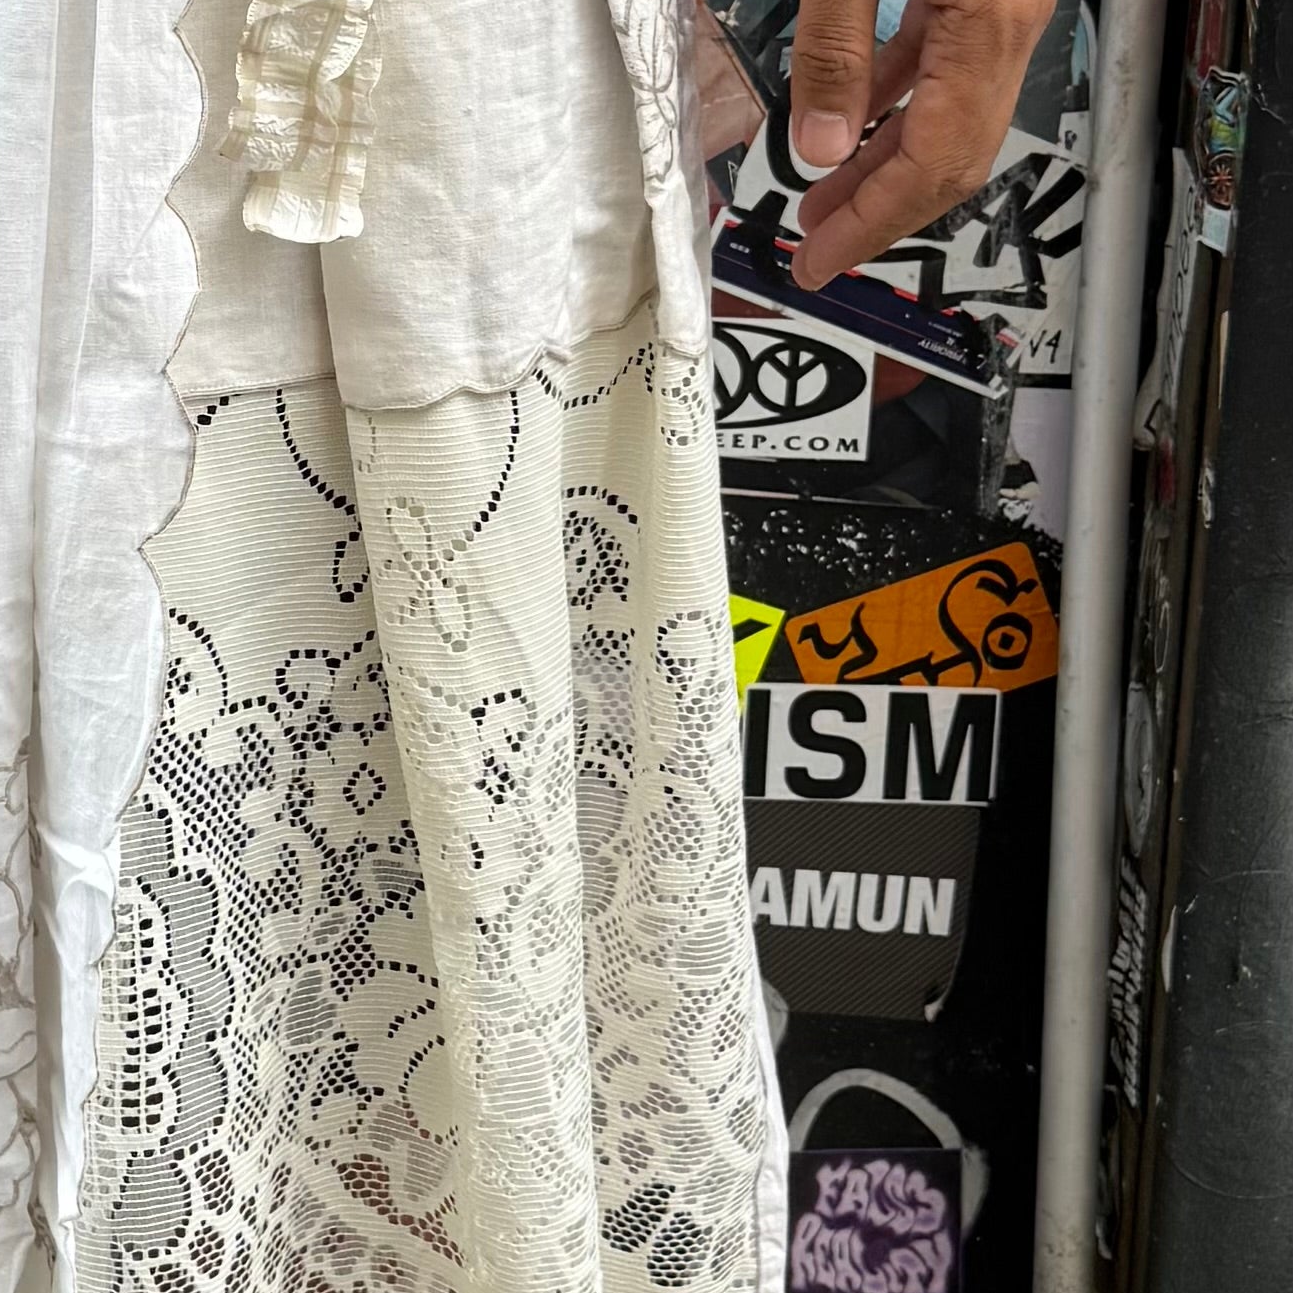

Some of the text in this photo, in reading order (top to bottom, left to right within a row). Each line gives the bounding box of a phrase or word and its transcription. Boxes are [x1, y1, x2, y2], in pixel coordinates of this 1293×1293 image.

[716, 433, 859, 453] EEP.COM
[744, 688, 997, 802] ISM
[751, 866, 957, 937] AMUN
